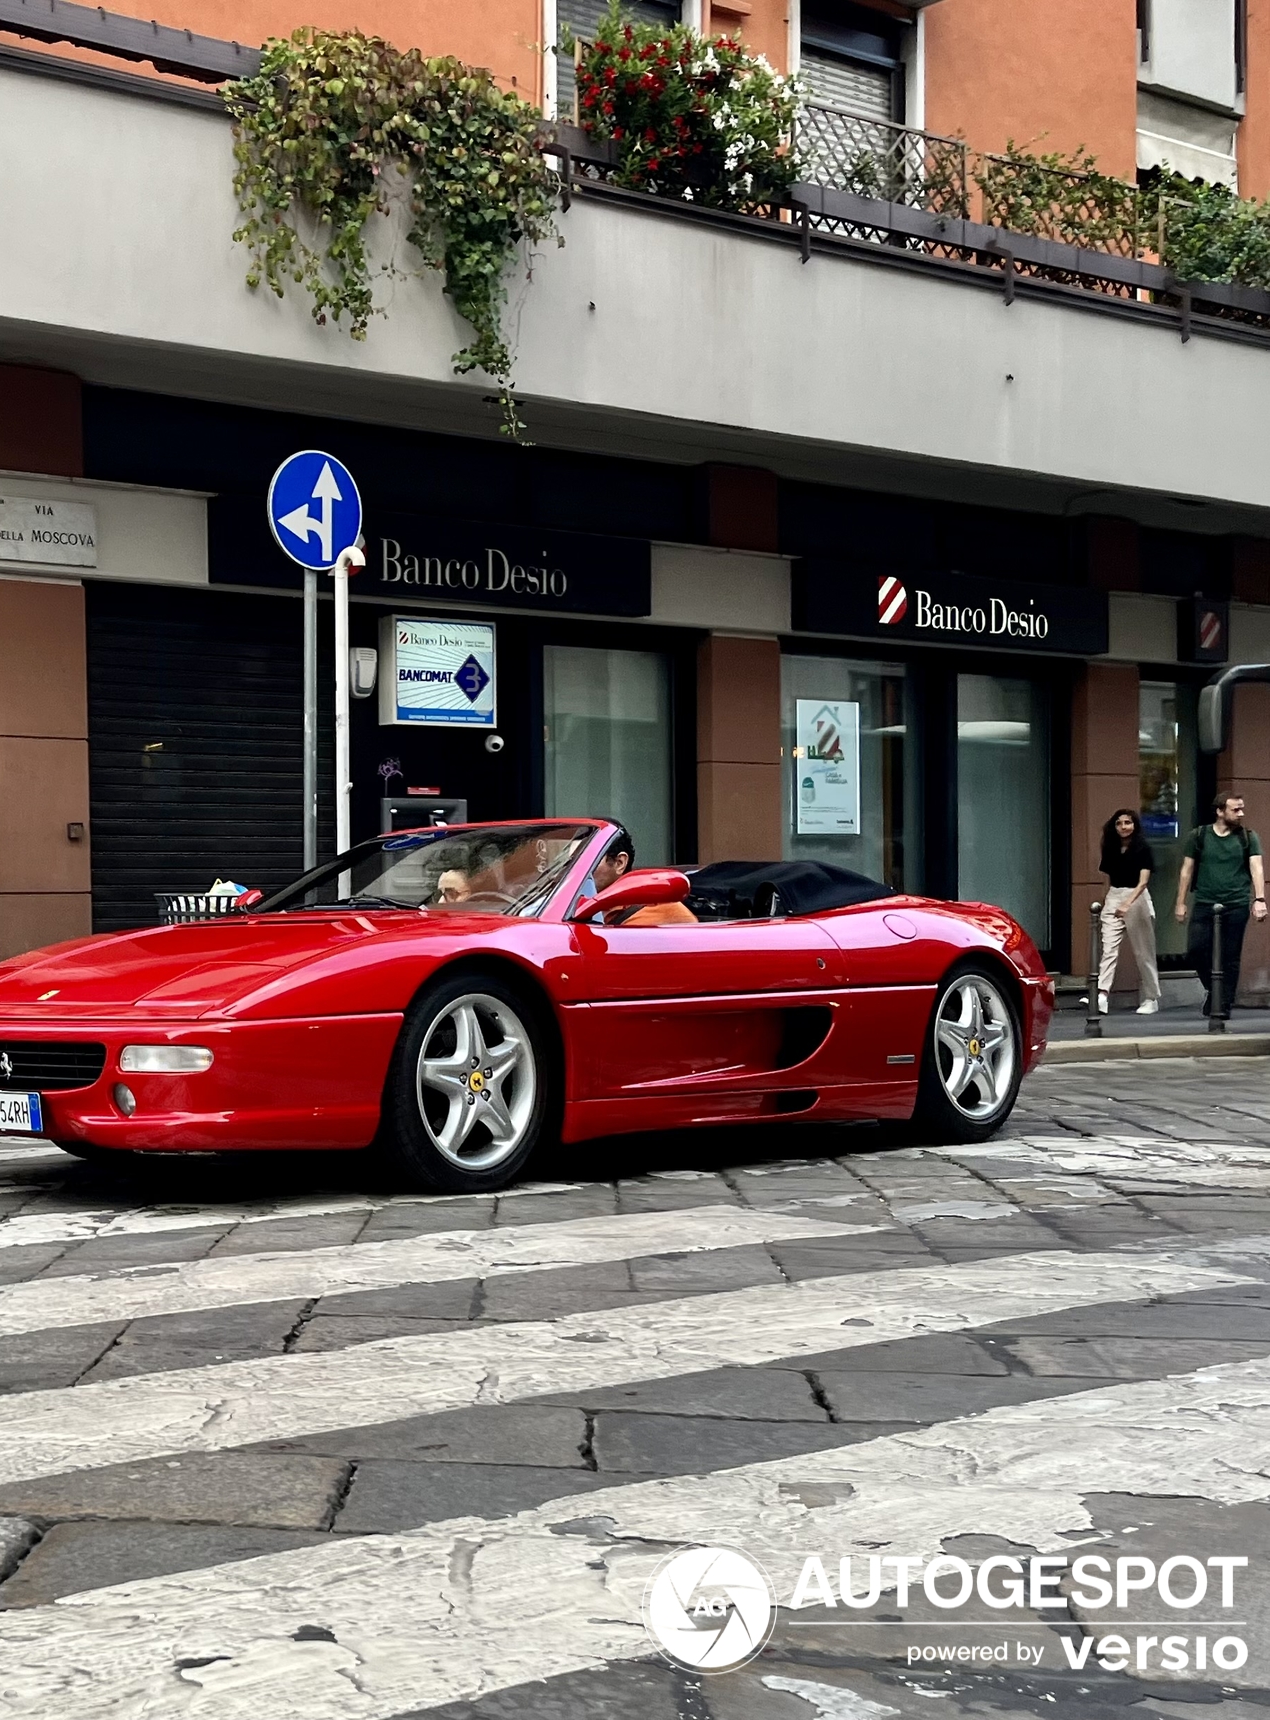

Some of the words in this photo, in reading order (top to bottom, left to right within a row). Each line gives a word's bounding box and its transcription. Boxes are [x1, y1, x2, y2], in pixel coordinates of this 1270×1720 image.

[34, 505, 54, 516] VIA
[31, 530, 95, 547] MOSCOVA
[380, 537, 480, 590] Banco
[484, 548, 568, 597] Desio
[915, 590, 986, 633] Banco
[989, 597, 1049, 639] Desio
[410, 632, 438, 646] Banco
[439, 634, 463, 647] Desio
[398, 668, 453, 684] BANCOMAT
